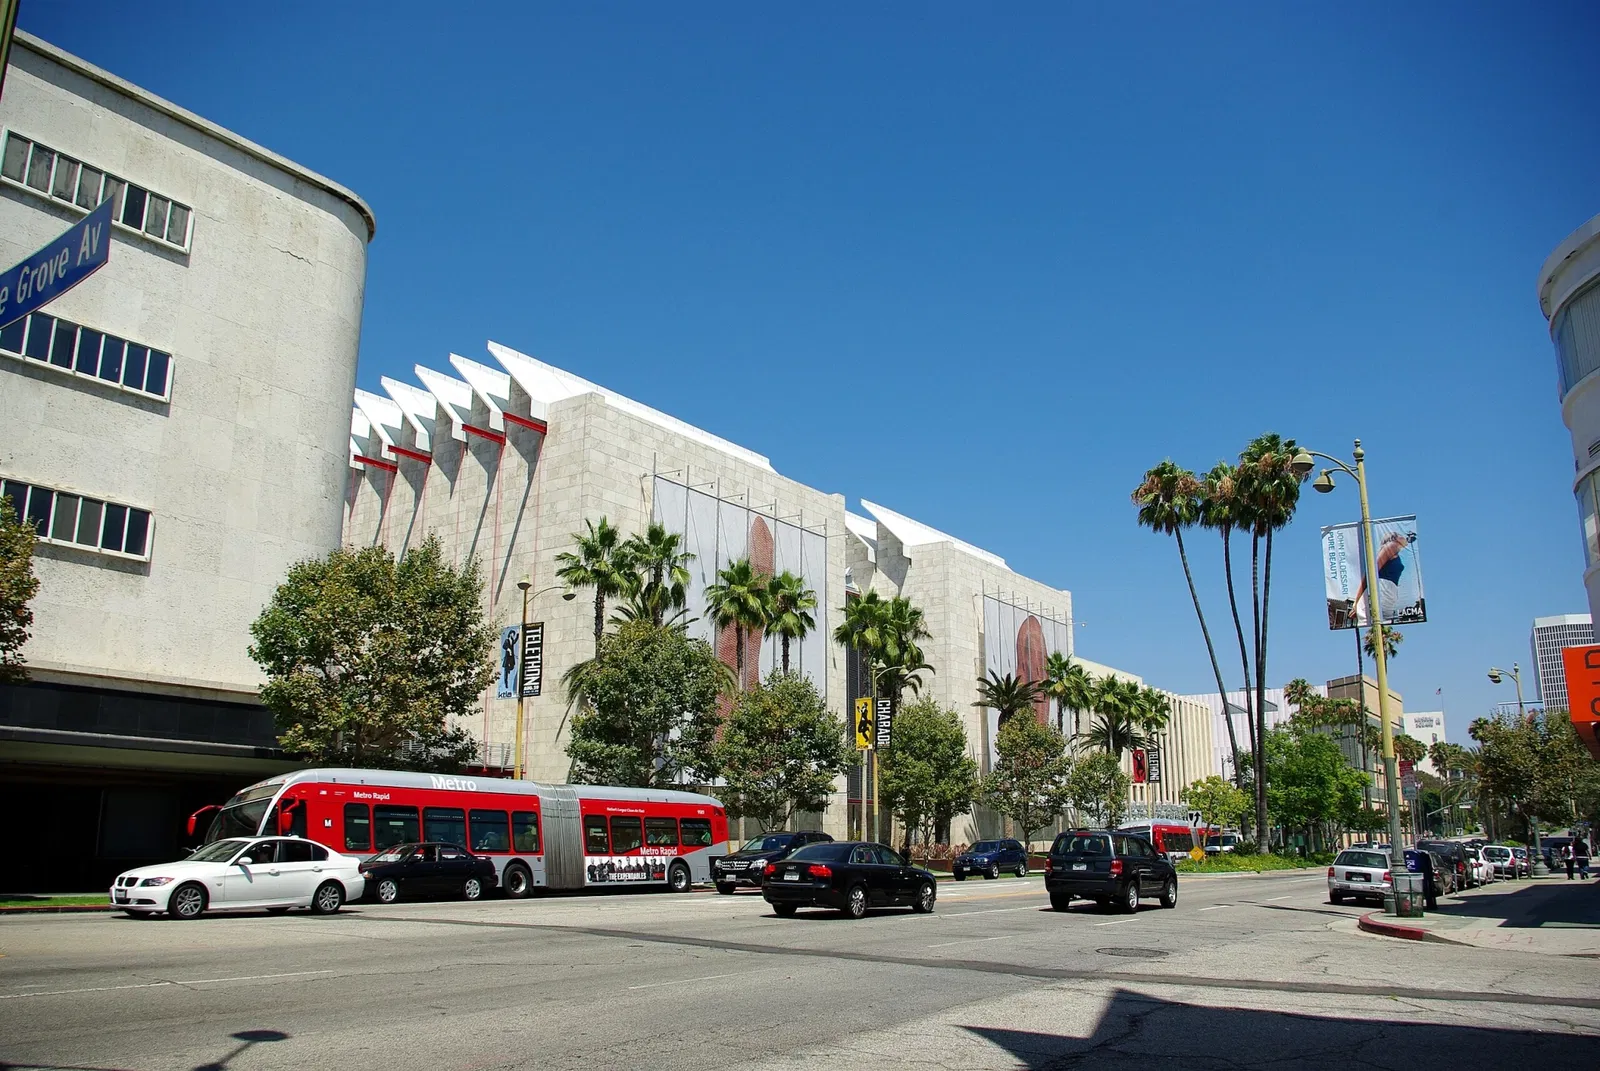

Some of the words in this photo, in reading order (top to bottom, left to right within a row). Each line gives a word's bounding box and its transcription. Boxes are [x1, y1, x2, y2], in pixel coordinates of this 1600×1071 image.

[16, 247, 70, 304] Grove
[77, 222, 102, 267] Av
[1337, 531, 1345, 550] JOHN
[1329, 552, 1338, 580] BEAUTY
[1339, 552, 1349, 595] BALDESSARI
[1397, 608, 1423, 617] LACMA
[523, 626, 542, 686] TELETHON
[877, 700, 891, 741] CHABAD
[430, 775, 477, 791] Metro
[353, 791, 373, 799] Metro
[373, 793, 390, 801] Rapid
[640, 847, 659, 856] Metro
[660, 846, 678, 857] Rapid
[609, 872, 617, 881] THE
[617, 872, 647, 881] EXPENDABLES
